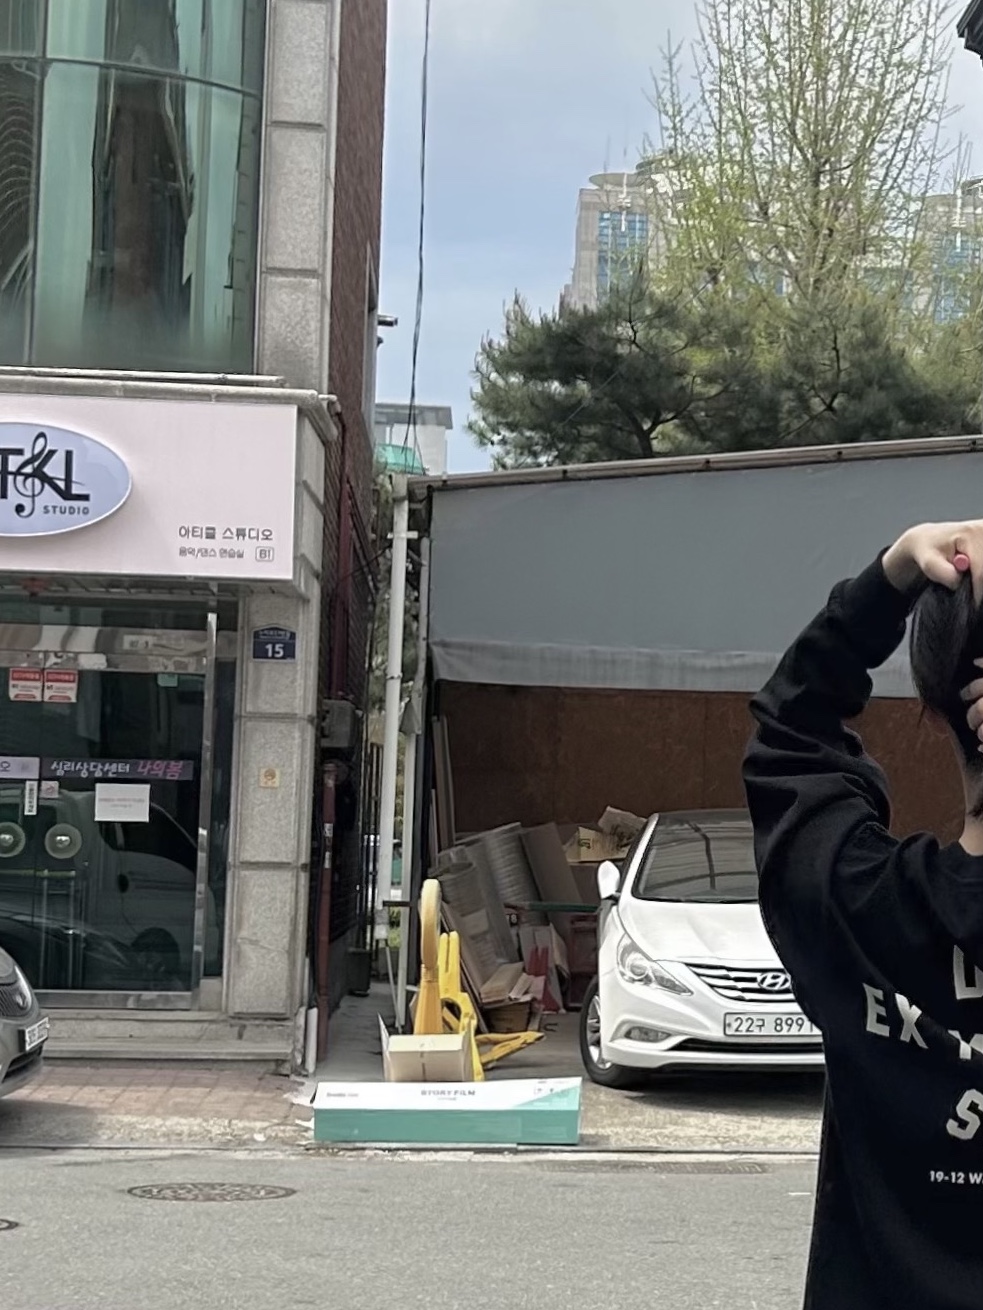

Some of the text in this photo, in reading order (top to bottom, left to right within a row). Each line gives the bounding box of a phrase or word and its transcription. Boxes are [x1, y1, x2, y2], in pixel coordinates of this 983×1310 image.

[43, 505, 89, 515] STUDIO
[179, 526, 273, 541] 아티클 스튜디오
[265, 643, 284, 658] 15
[51, 760, 130, 778] 심리상담센터
[137, 760, 184, 780] 나의봄
[862, 983, 929, 1050] EX
[734, 1016, 766, 1033] 22구
[929, 1170, 965, 1185] 19-12
